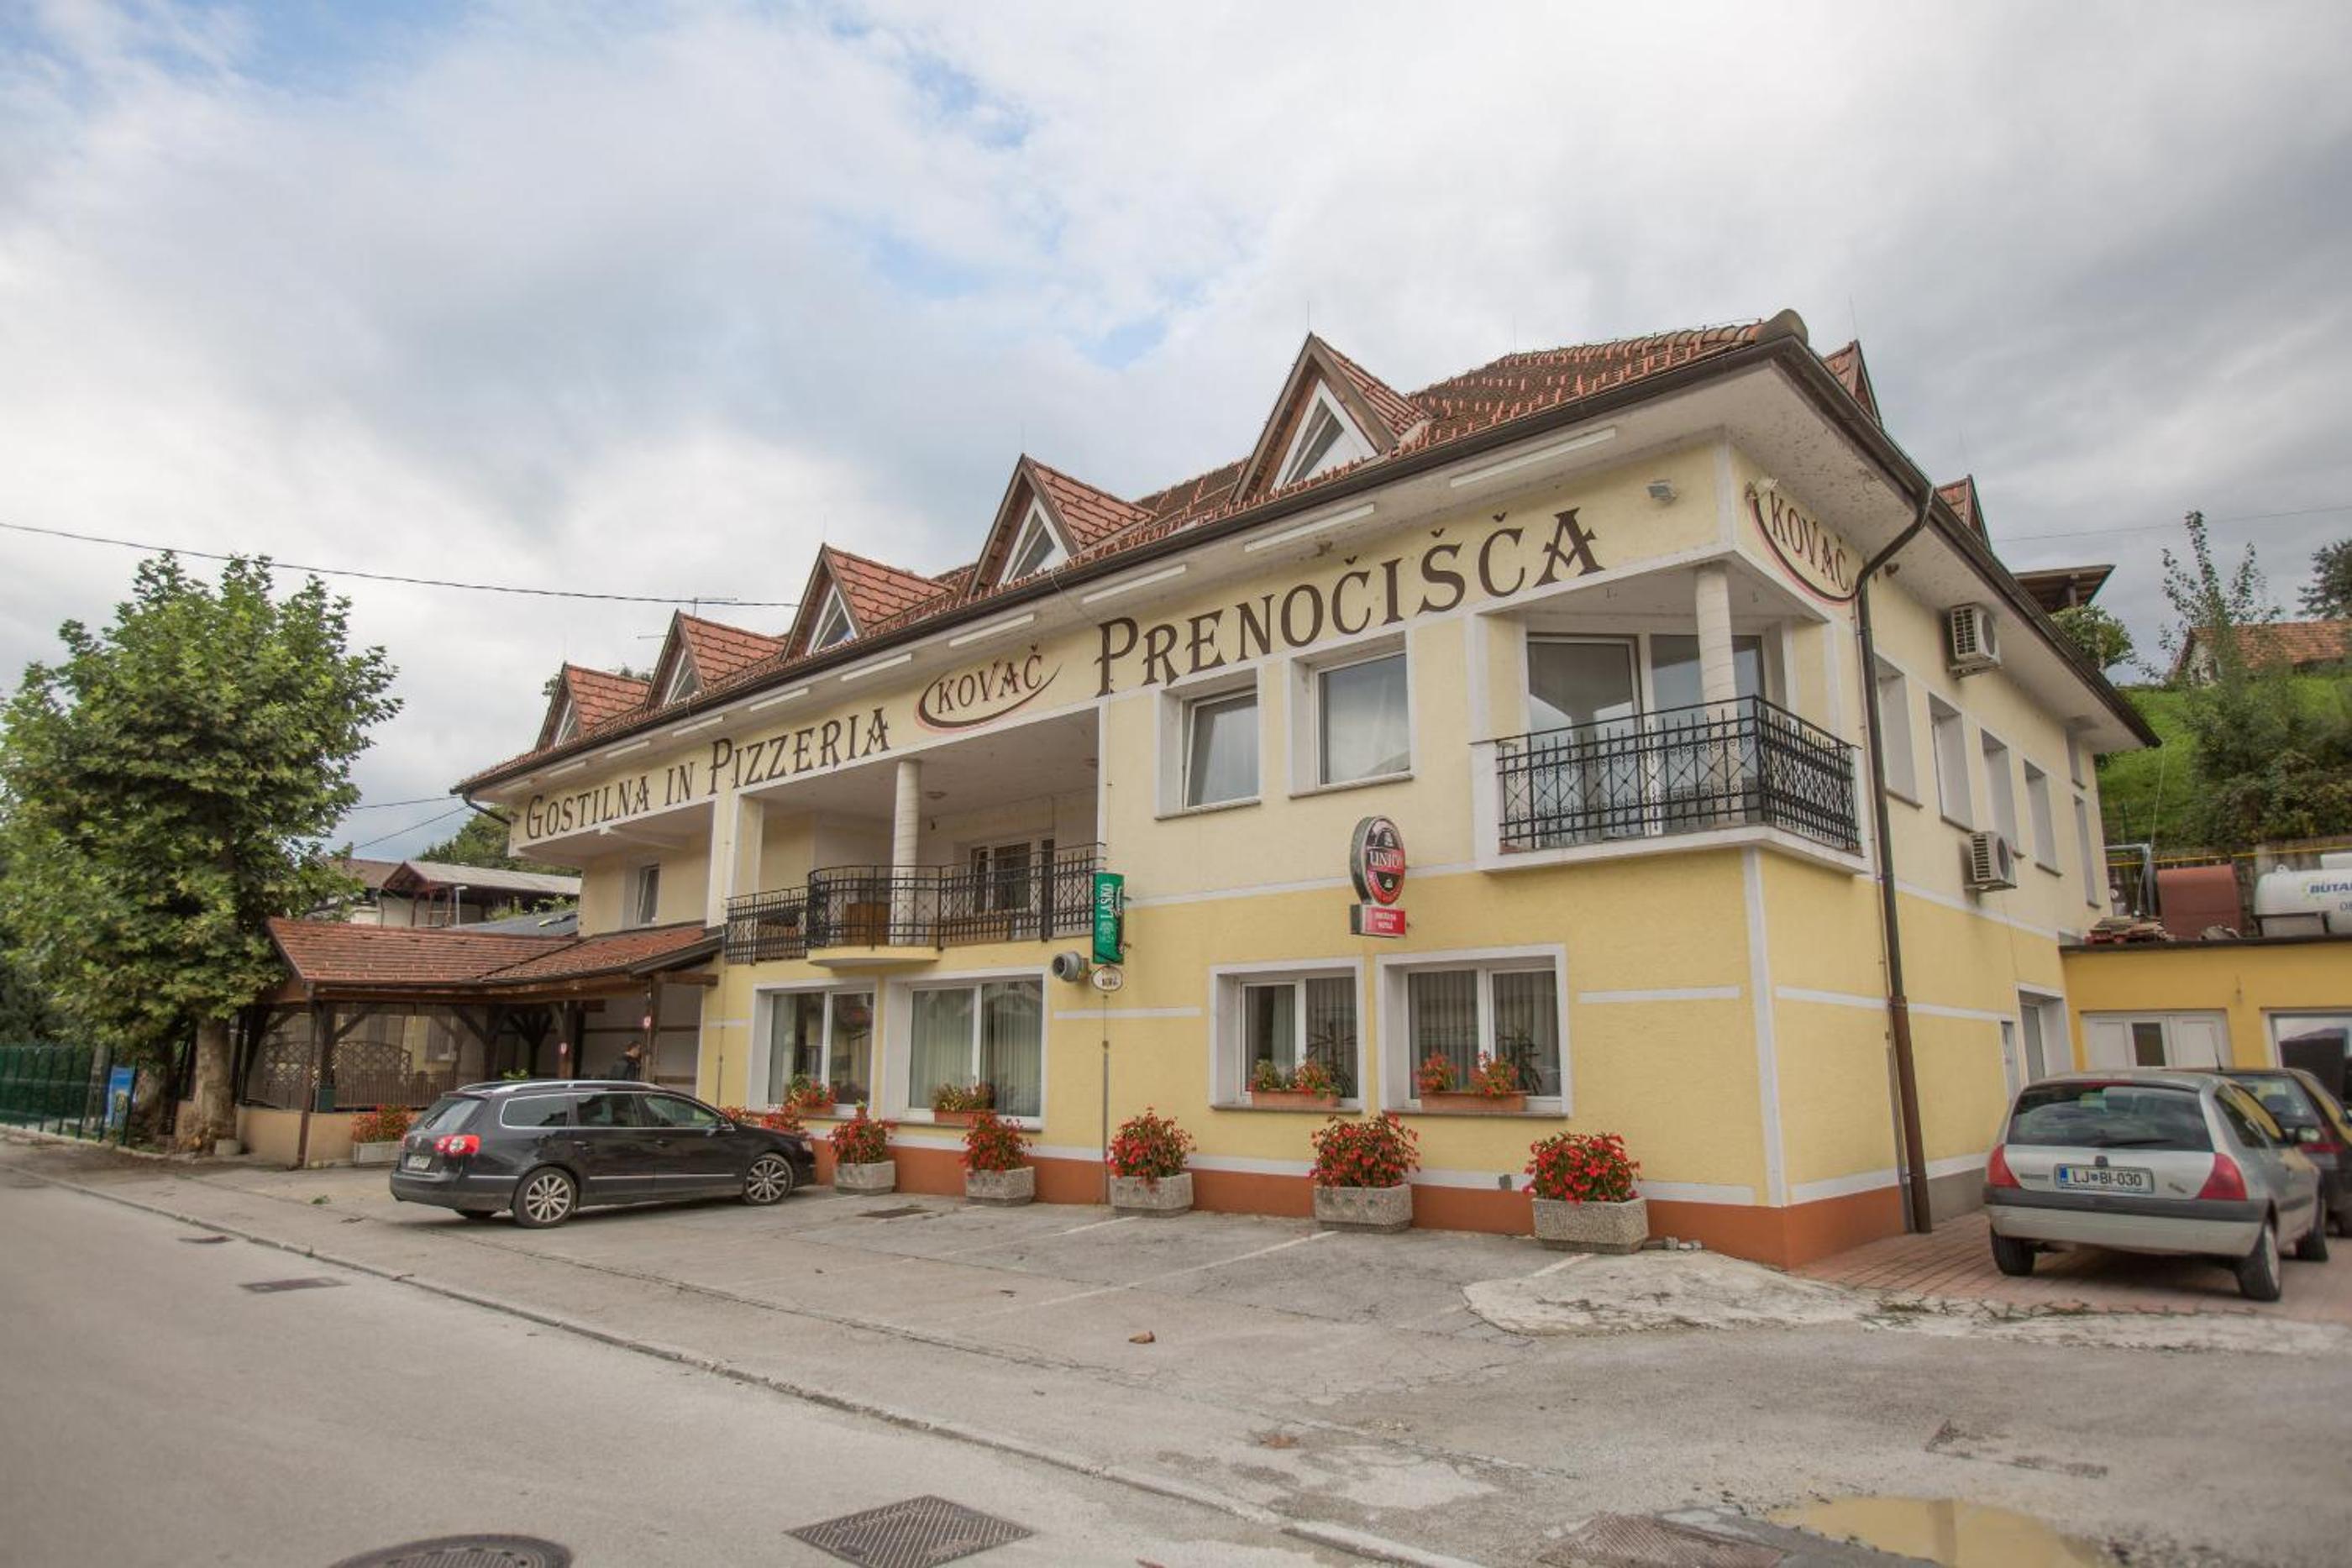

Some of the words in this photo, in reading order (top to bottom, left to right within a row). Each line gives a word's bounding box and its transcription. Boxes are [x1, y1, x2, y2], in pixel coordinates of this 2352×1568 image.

[1770, 490, 1850, 591] KOVAČ
[1095, 507, 1605, 697] PRENOČIŠČA
[937, 643, 1042, 714] KOVAČ
[526, 775, 649, 840] GOSTILNA
[664, 759, 693, 805] IN
[708, 707, 891, 794] PIZZERIA
[2309, 882, 2352, 894] BUTA
[2073, 1171, 2089, 1183] LJ
